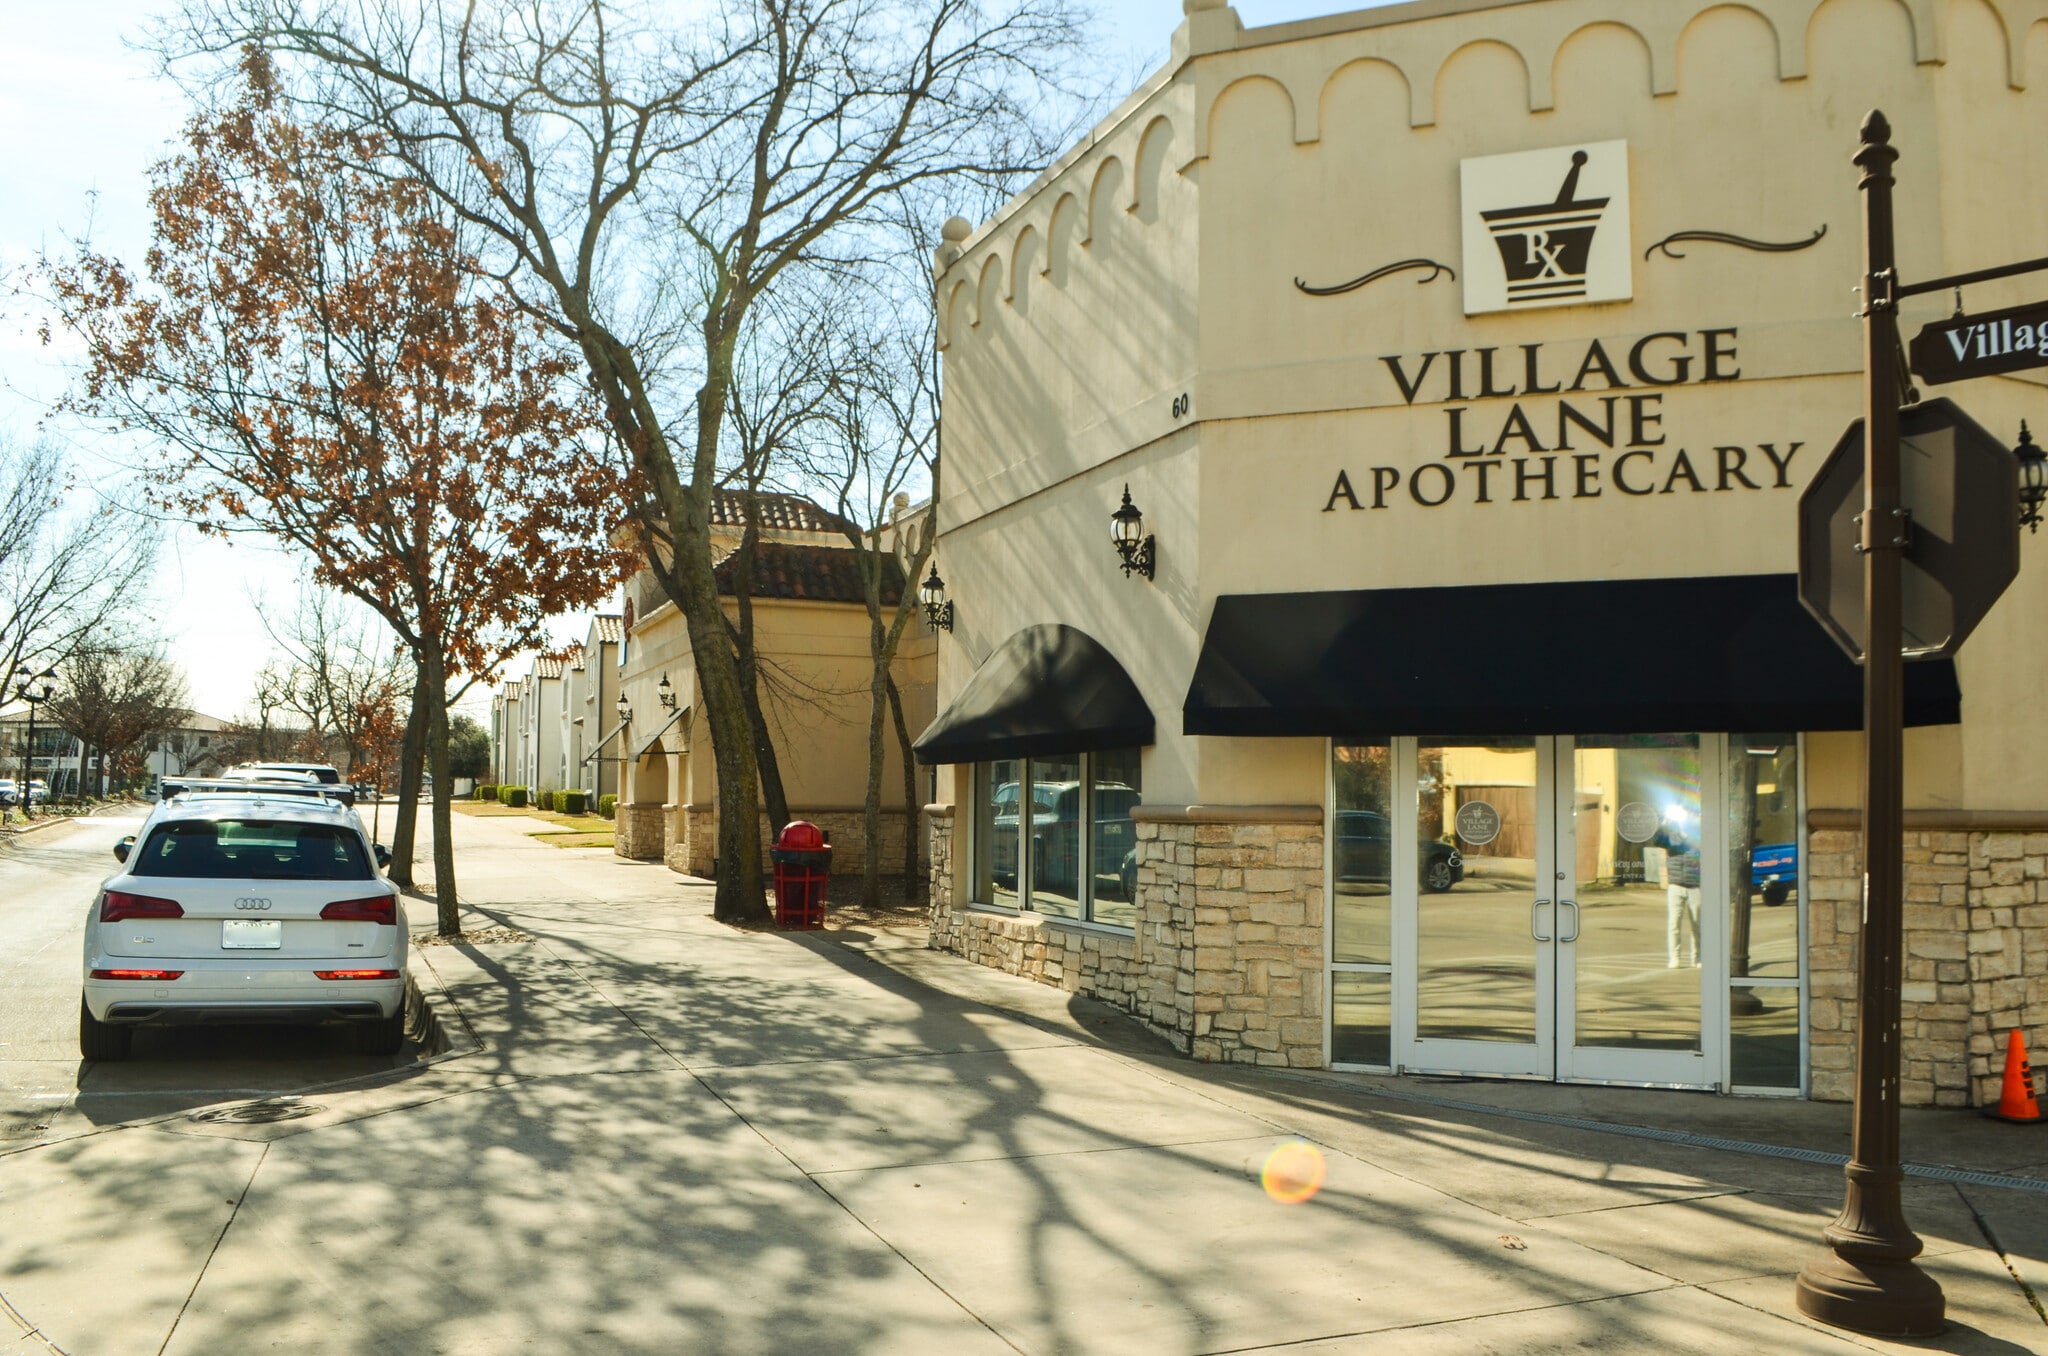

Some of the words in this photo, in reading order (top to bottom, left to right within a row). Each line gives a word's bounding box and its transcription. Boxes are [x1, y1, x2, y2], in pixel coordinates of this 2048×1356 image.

[1379, 327, 1741, 405] VILLAGE
[1172, 392, 1188, 419] 60
[1442, 393, 1666, 458] LANE
[1321, 441, 1805, 513] APOTHECARY
